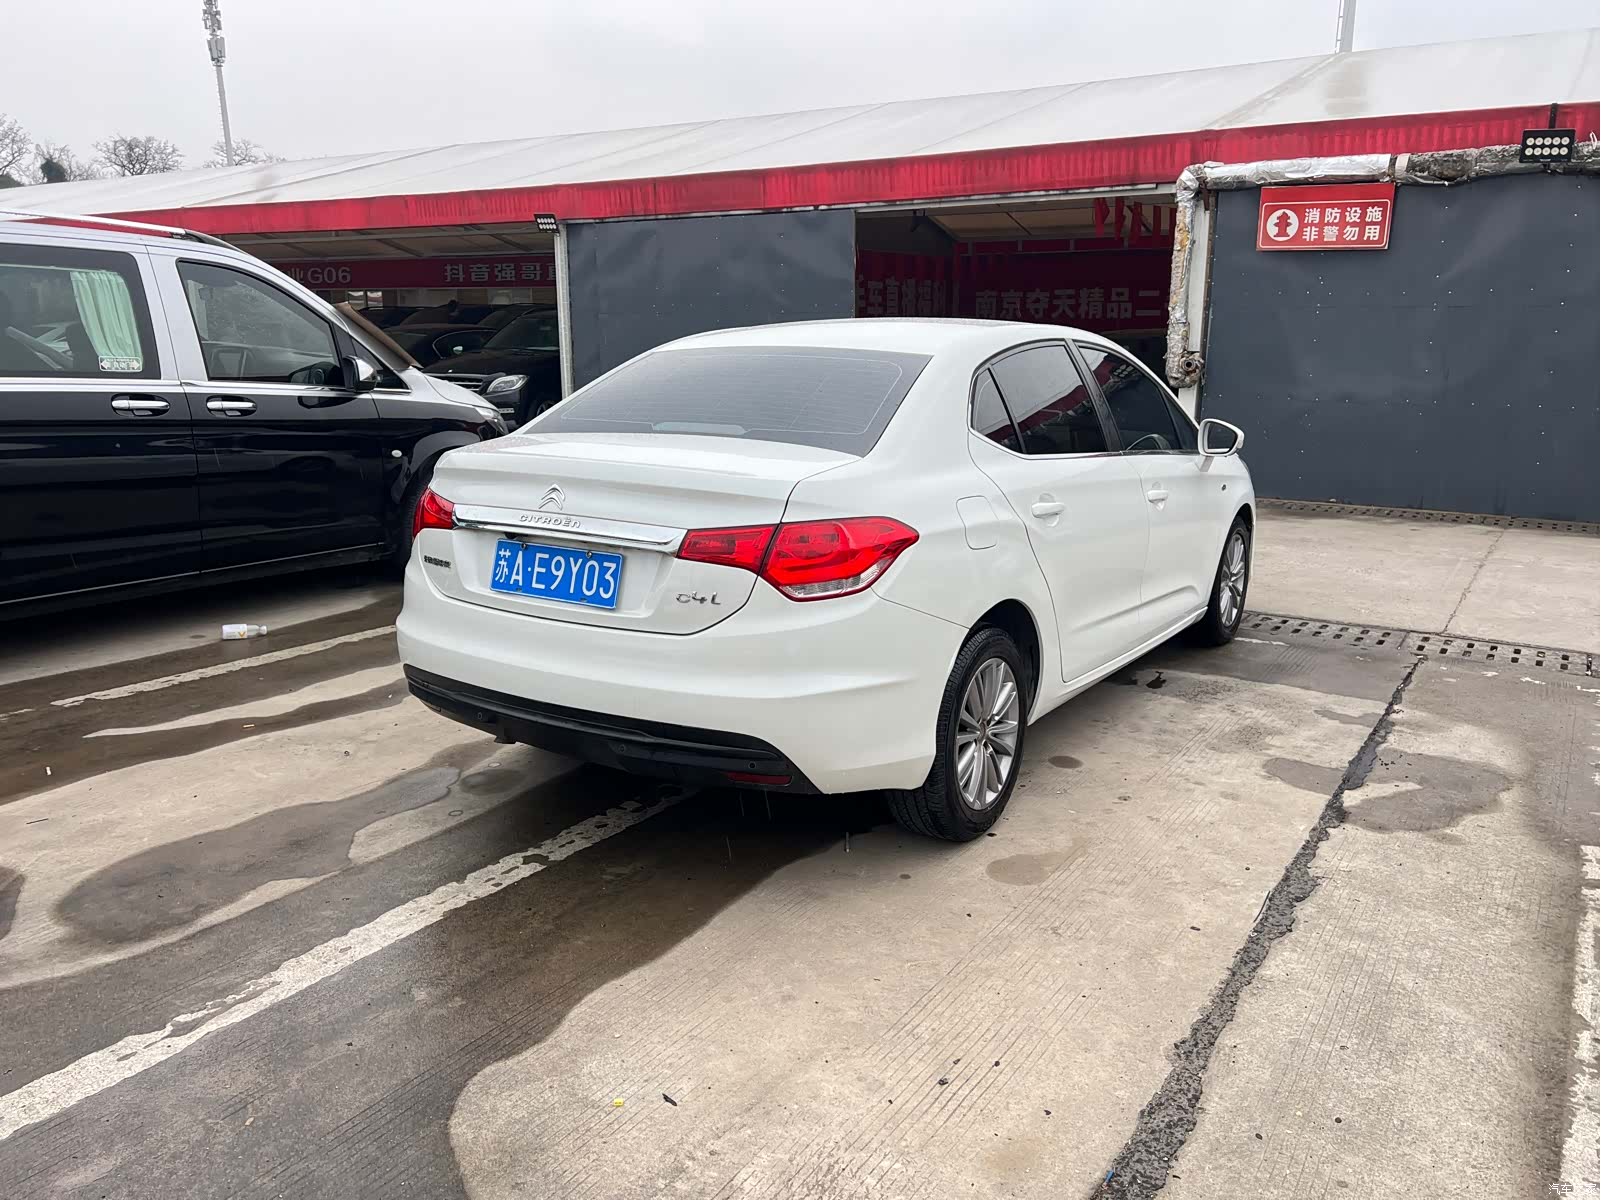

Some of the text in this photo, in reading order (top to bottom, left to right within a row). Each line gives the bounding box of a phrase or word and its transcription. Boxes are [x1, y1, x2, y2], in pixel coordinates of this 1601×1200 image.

[1303, 206, 1383, 224] 消防设施
[1302, 225, 1381, 241] 非警勿用
